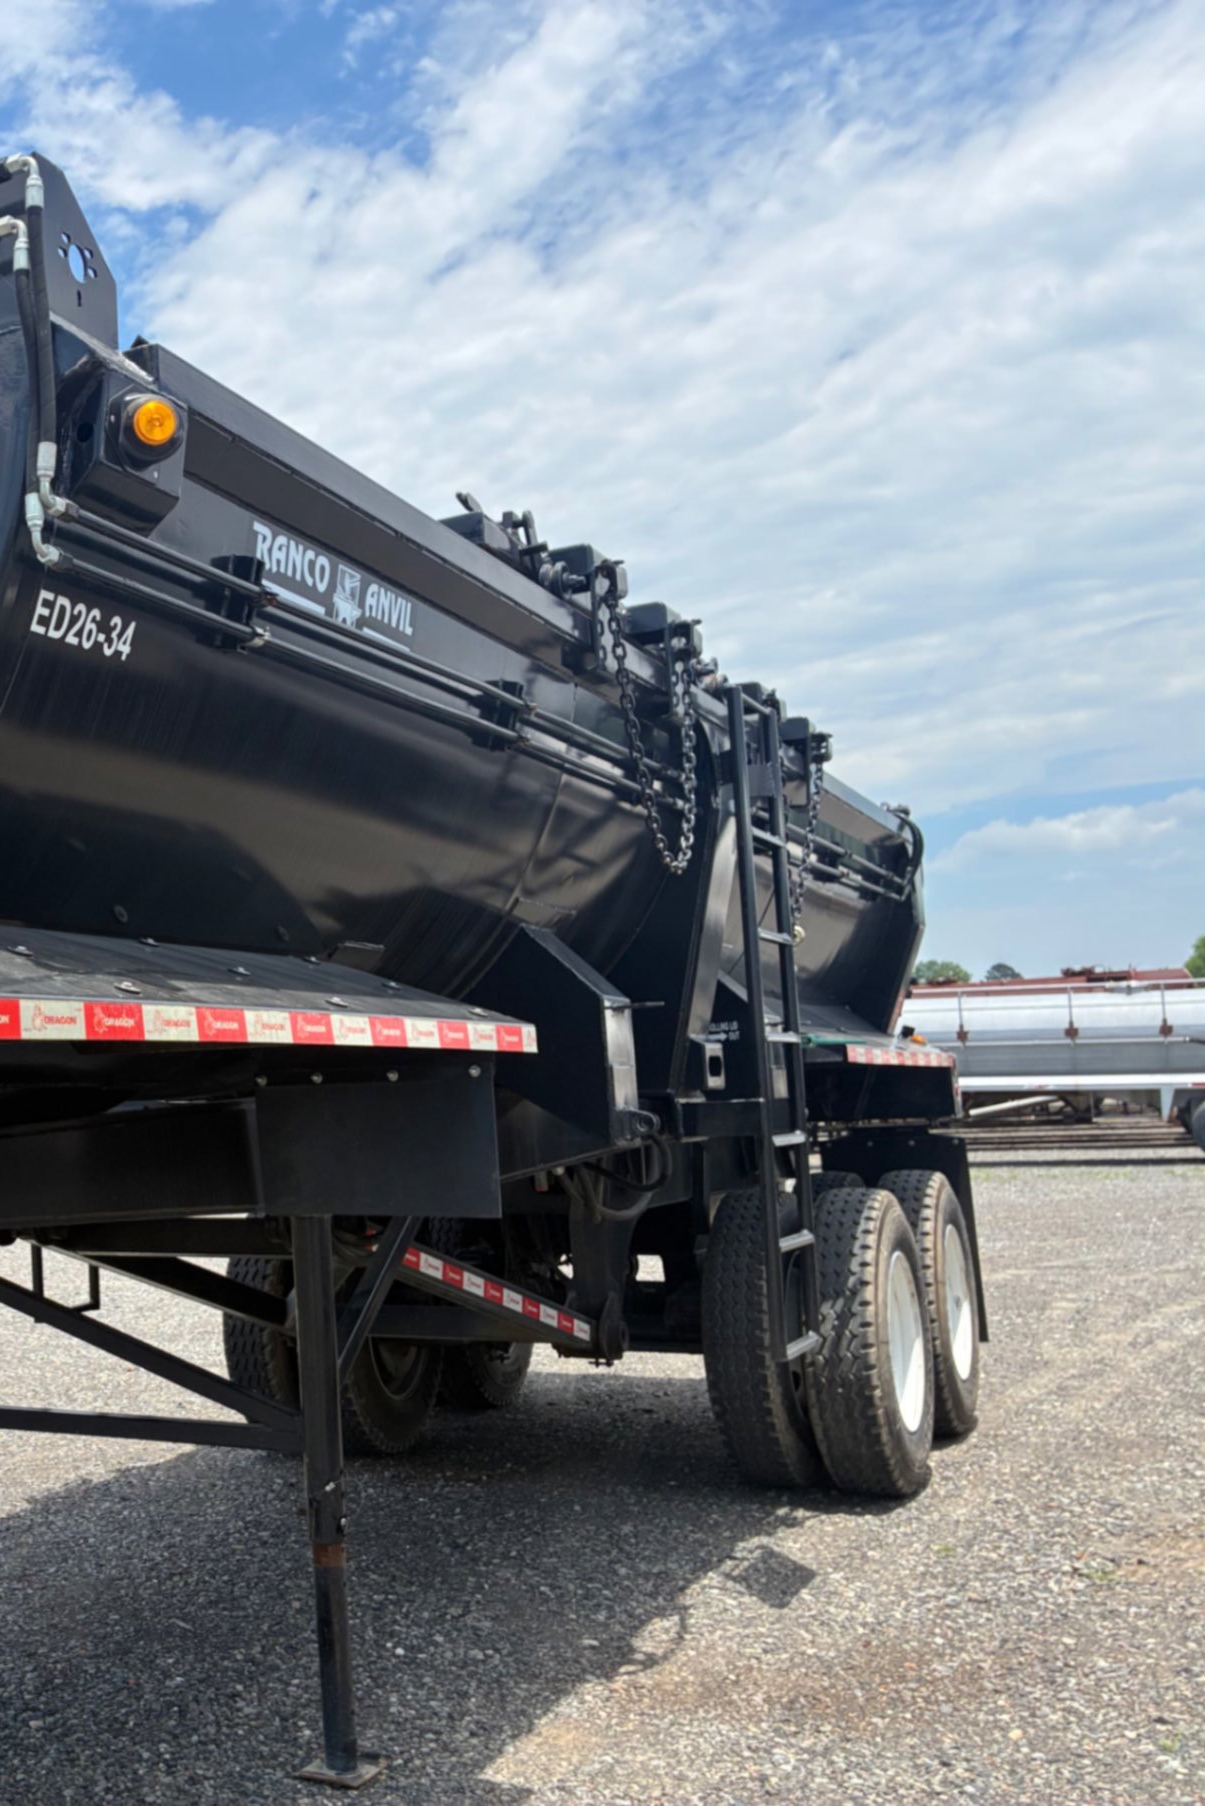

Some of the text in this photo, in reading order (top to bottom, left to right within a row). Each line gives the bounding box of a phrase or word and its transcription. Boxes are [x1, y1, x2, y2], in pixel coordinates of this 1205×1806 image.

[253, 520, 414, 636] RANCO ANVIL
[30, 588, 137, 661] ED26-34
[43, 1015, 77, 1025] DRAGON
[104, 1016, 135, 1028] DRAGON
